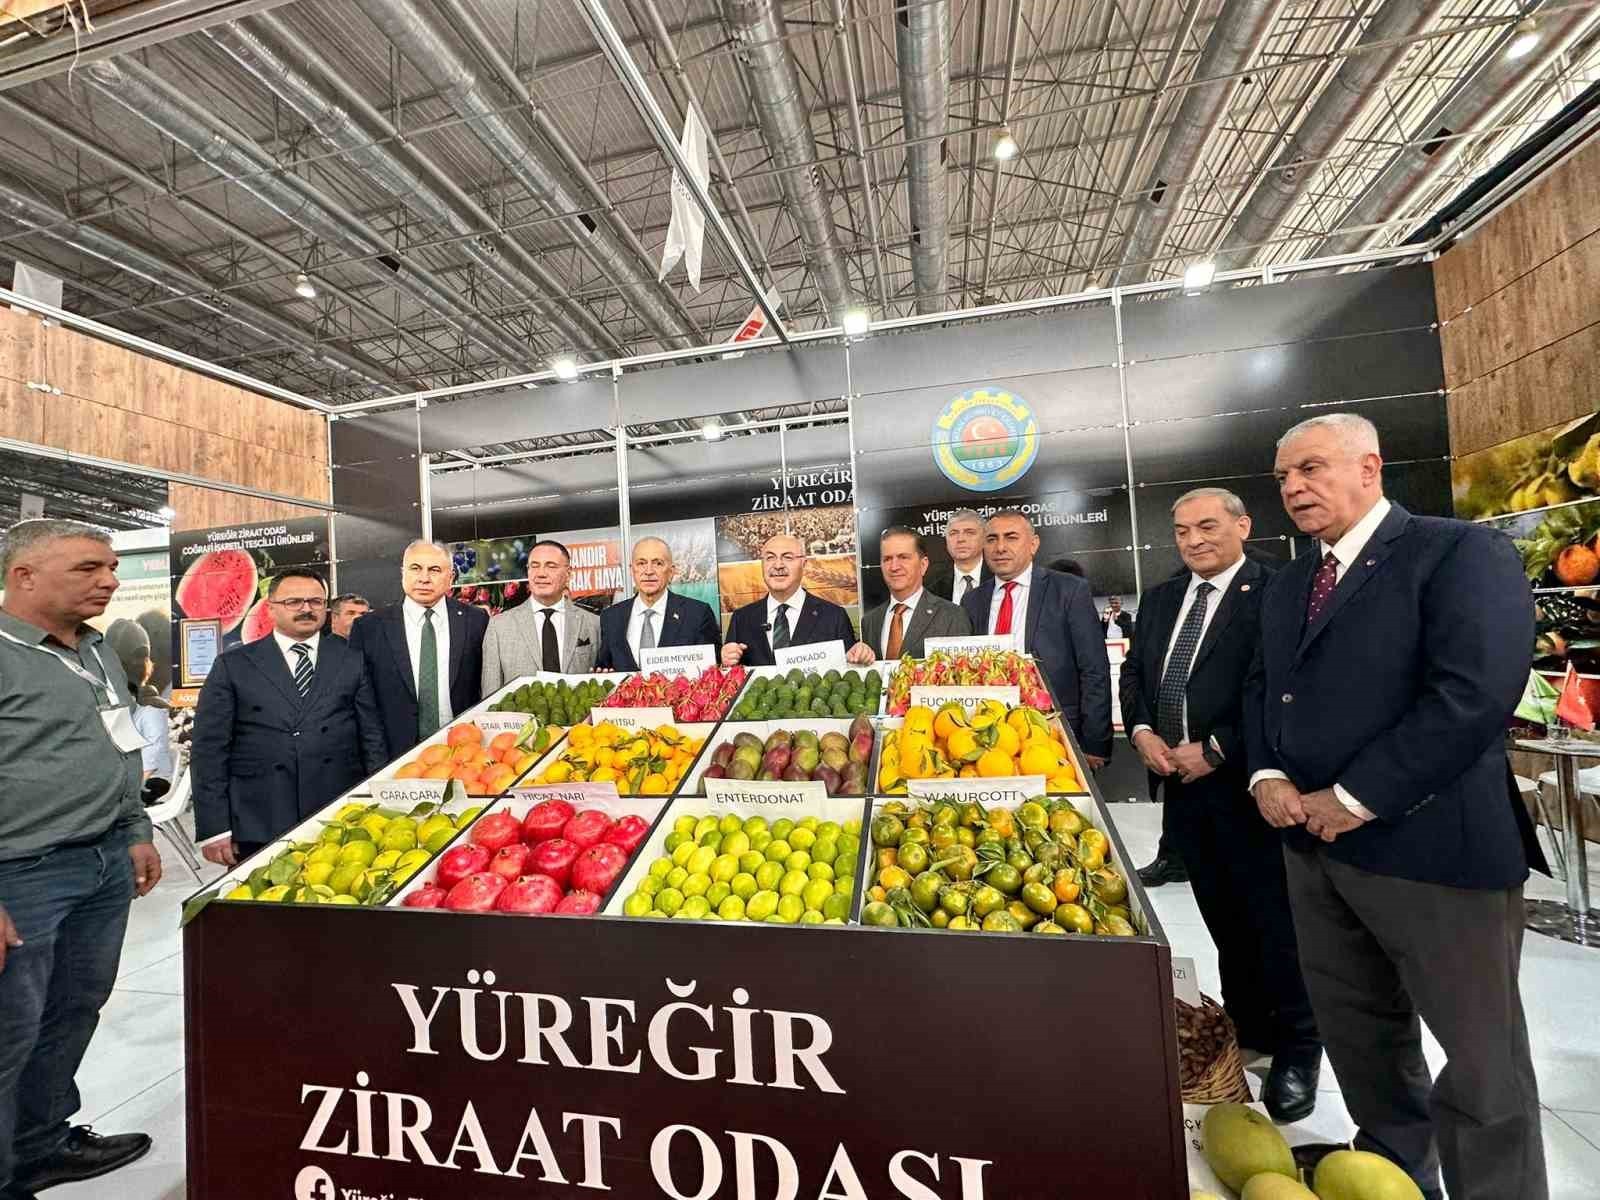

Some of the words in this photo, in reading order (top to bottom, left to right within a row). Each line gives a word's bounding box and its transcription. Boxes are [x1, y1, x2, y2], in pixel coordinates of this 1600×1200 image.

[751, 488, 817, 511] ZİRAAT
[1043, 511, 1108, 527] ÜRÜNLERİ
[238, 527, 264, 540] ZİRAAT
[263, 525, 287, 537] ODASI
[182, 543, 214, 556] COĞRAFİ
[276, 531, 315, 546] ÜRÜNLERİ
[786, 651, 827, 665] AVOKADO
[380, 790, 408, 801] CARA
[408, 790, 441, 801] CARA
[715, 792, 804, 804] ENTERDONAT
[391, 969, 847, 1095] YÜREĞİR
[299, 1071, 622, 1191] ZİRAAT
[648, 1123, 994, 1200] ODASI
